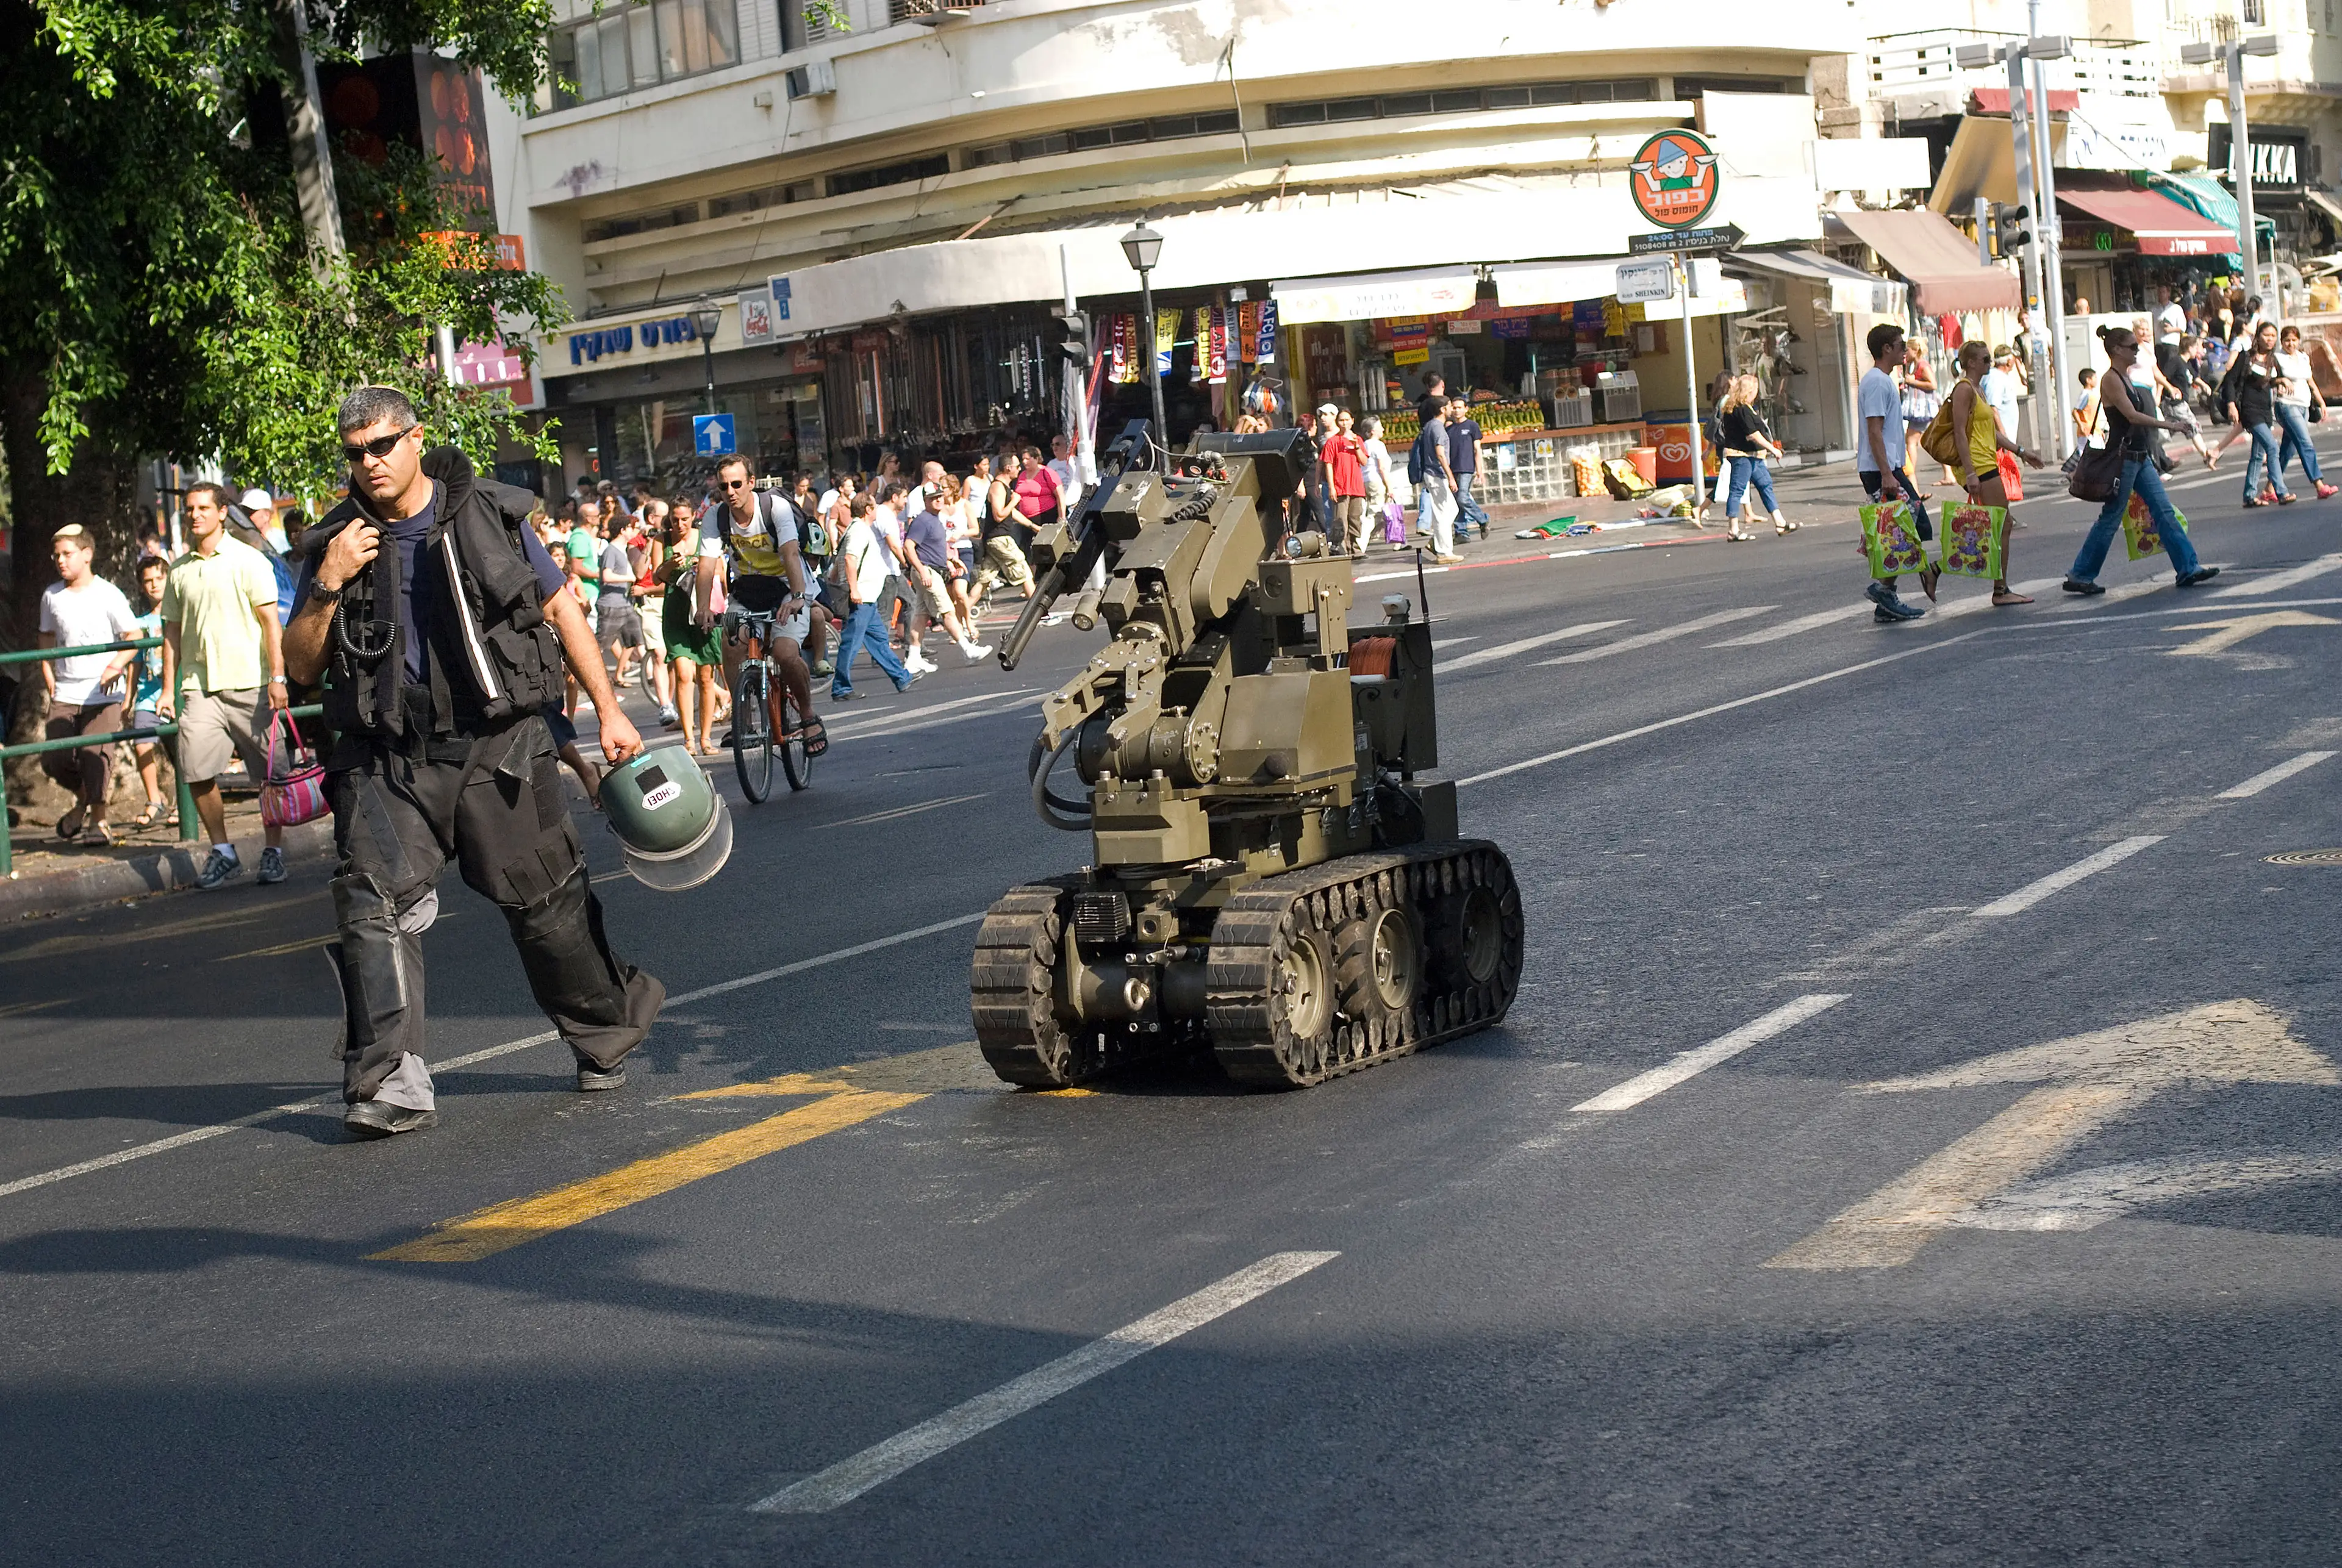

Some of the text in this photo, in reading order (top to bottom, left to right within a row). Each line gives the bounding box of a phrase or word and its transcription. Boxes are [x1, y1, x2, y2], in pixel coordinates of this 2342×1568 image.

[1655, 205, 1699, 217] חומוס פול
[1692, 229, 1714, 238] פתוח
[1686, 237, 1708, 248] בנימין
[1710, 234, 1730, 245] נחלת
[1635, 288, 1665, 298] SHEINKIN
[1262, 317, 1275, 333] FC
[648, 787, 675, 806] SHOEI
